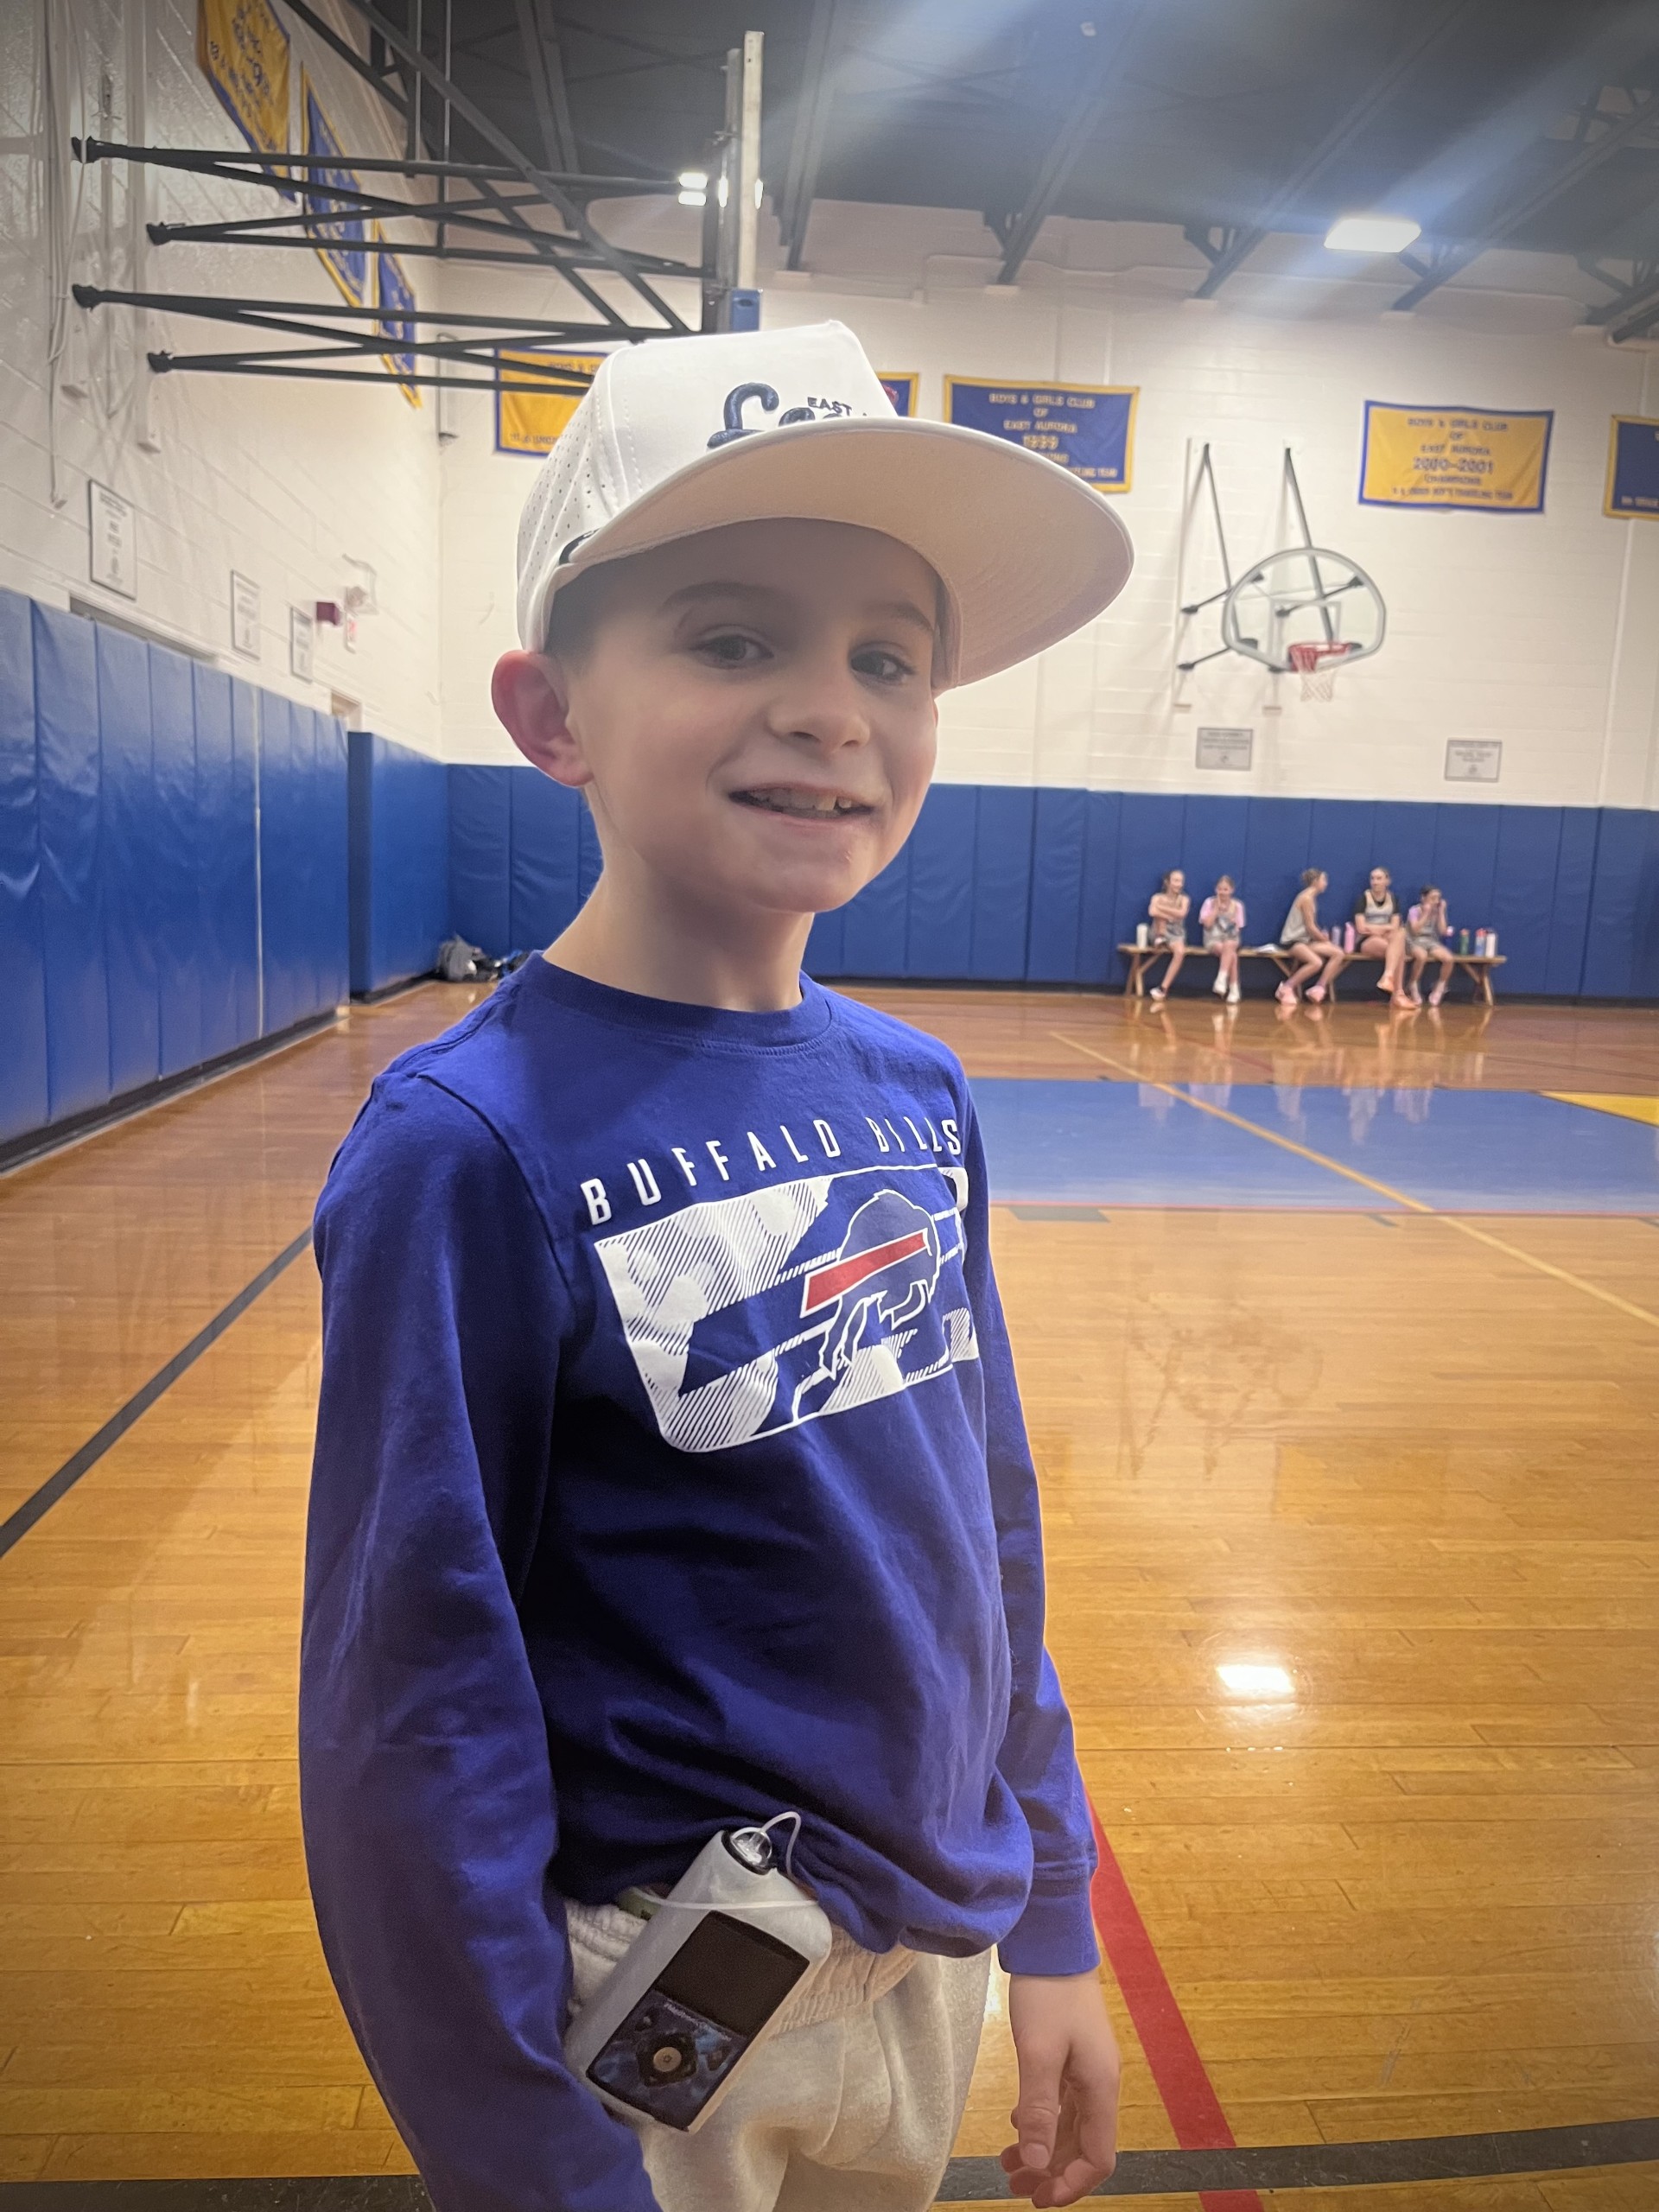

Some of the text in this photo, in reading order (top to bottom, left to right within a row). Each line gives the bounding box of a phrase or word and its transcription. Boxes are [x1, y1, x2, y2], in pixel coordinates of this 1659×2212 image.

[807, 397, 852, 416] EAST
[989, 393, 1017, 404] BOYS
[1033, 394, 1064, 406] GIRLS
[1066, 396, 1096, 409] CLUB
[1033, 407, 1049, 418] OF
[1003, 420, 1077, 434] EAST AURORA
[1414, 457, 1494, 474] 2000-2001
[581, 1116, 962, 1225] BUFFALO BILLS
